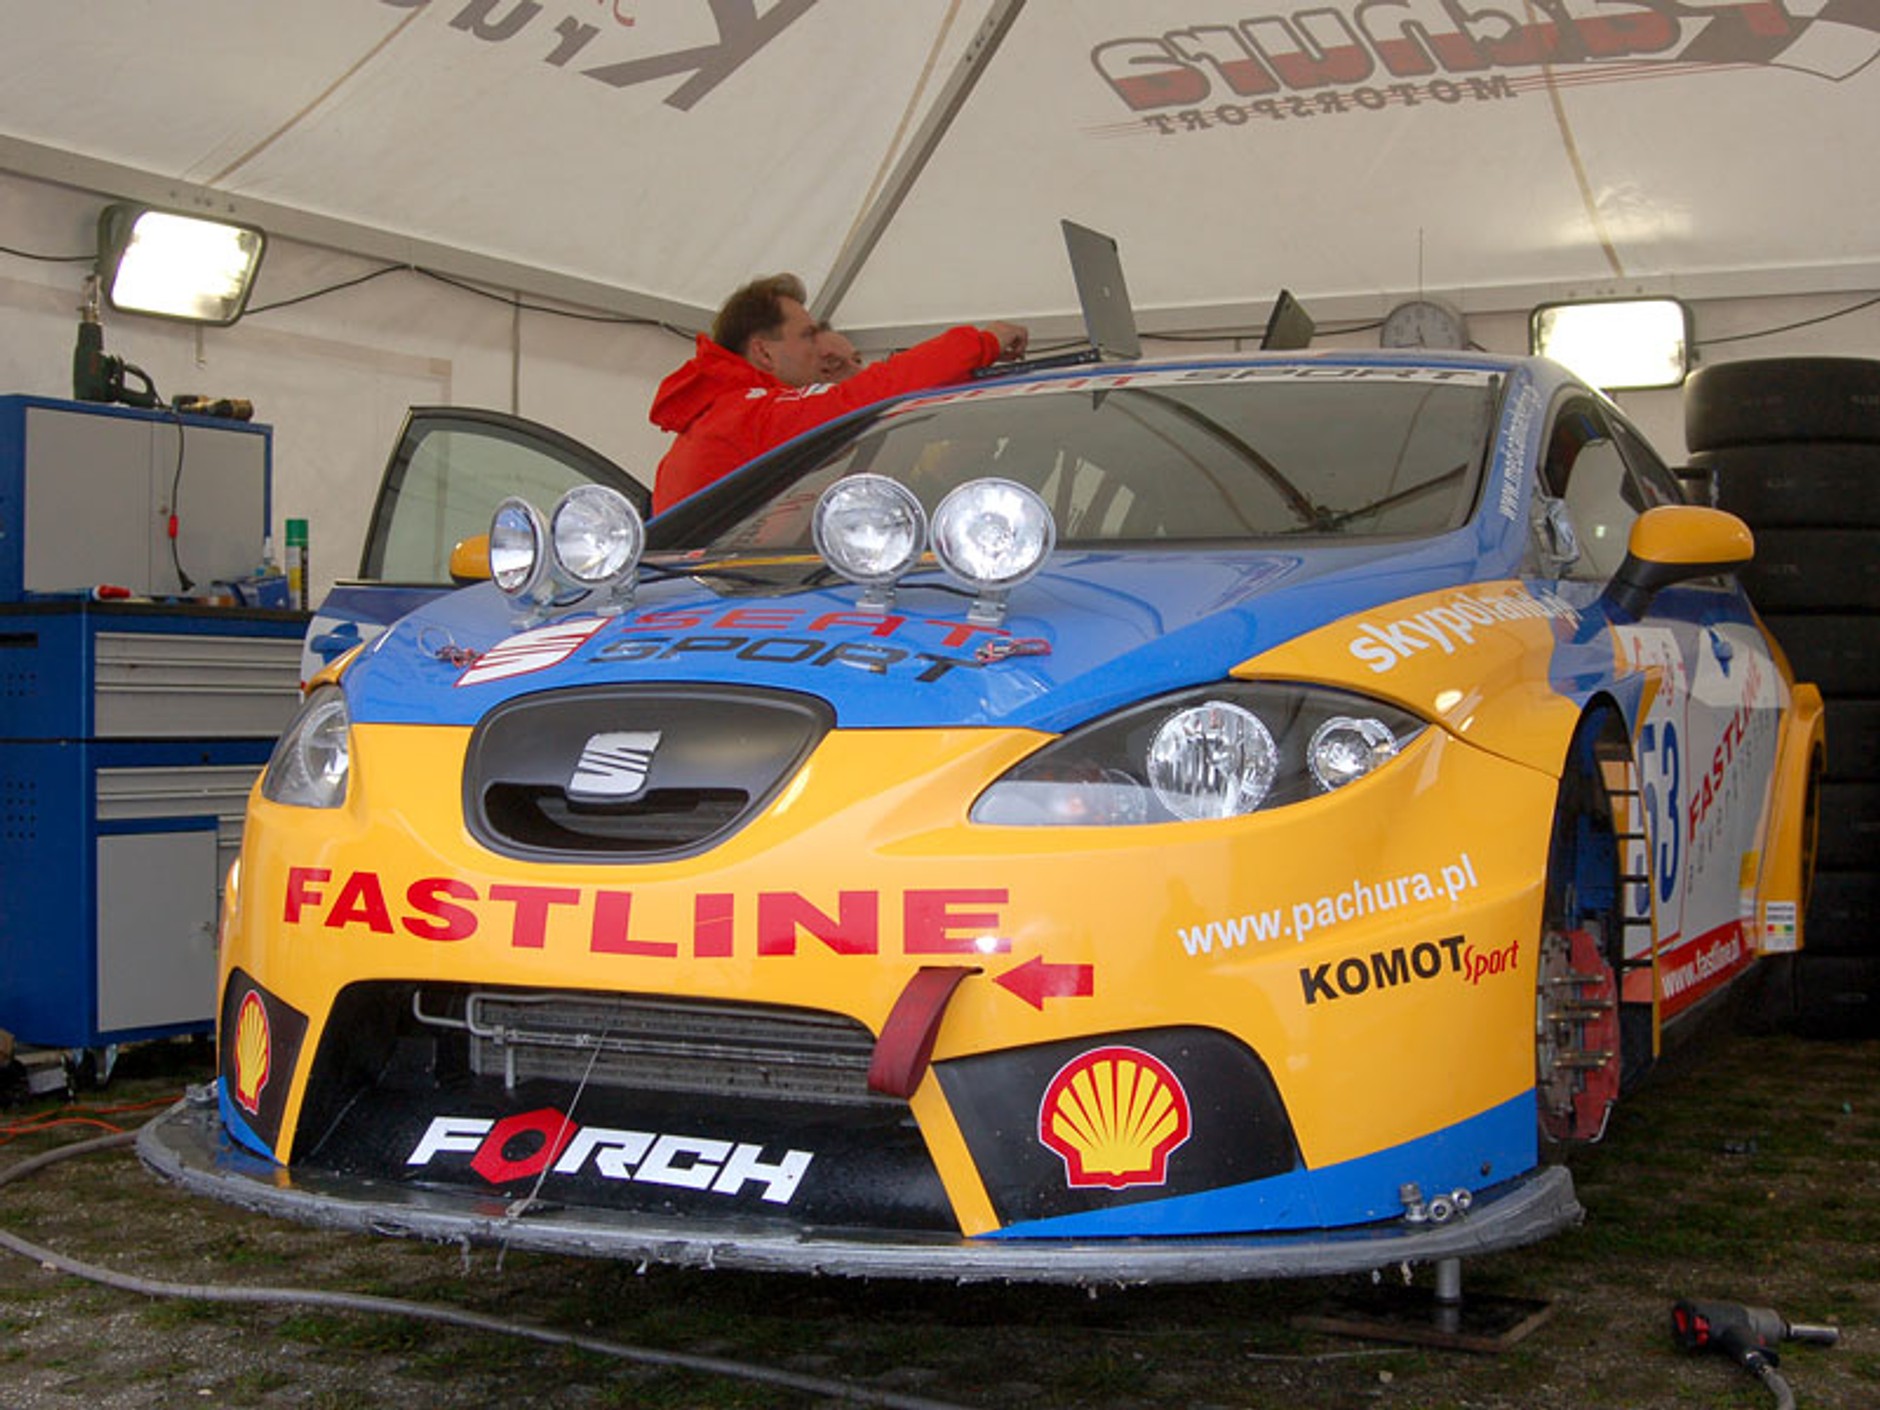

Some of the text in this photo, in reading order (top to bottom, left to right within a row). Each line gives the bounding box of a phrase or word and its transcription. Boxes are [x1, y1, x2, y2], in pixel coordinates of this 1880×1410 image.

[1175, 366, 1478, 382] SPORT
[588, 636, 990, 683] SPORT
[622, 608, 1012, 650] SEAT
[283, 866, 1012, 958] FASTLINE
[1177, 852, 1479, 956] www.pachura.pl
[405, 1106, 815, 1204] FORCH
